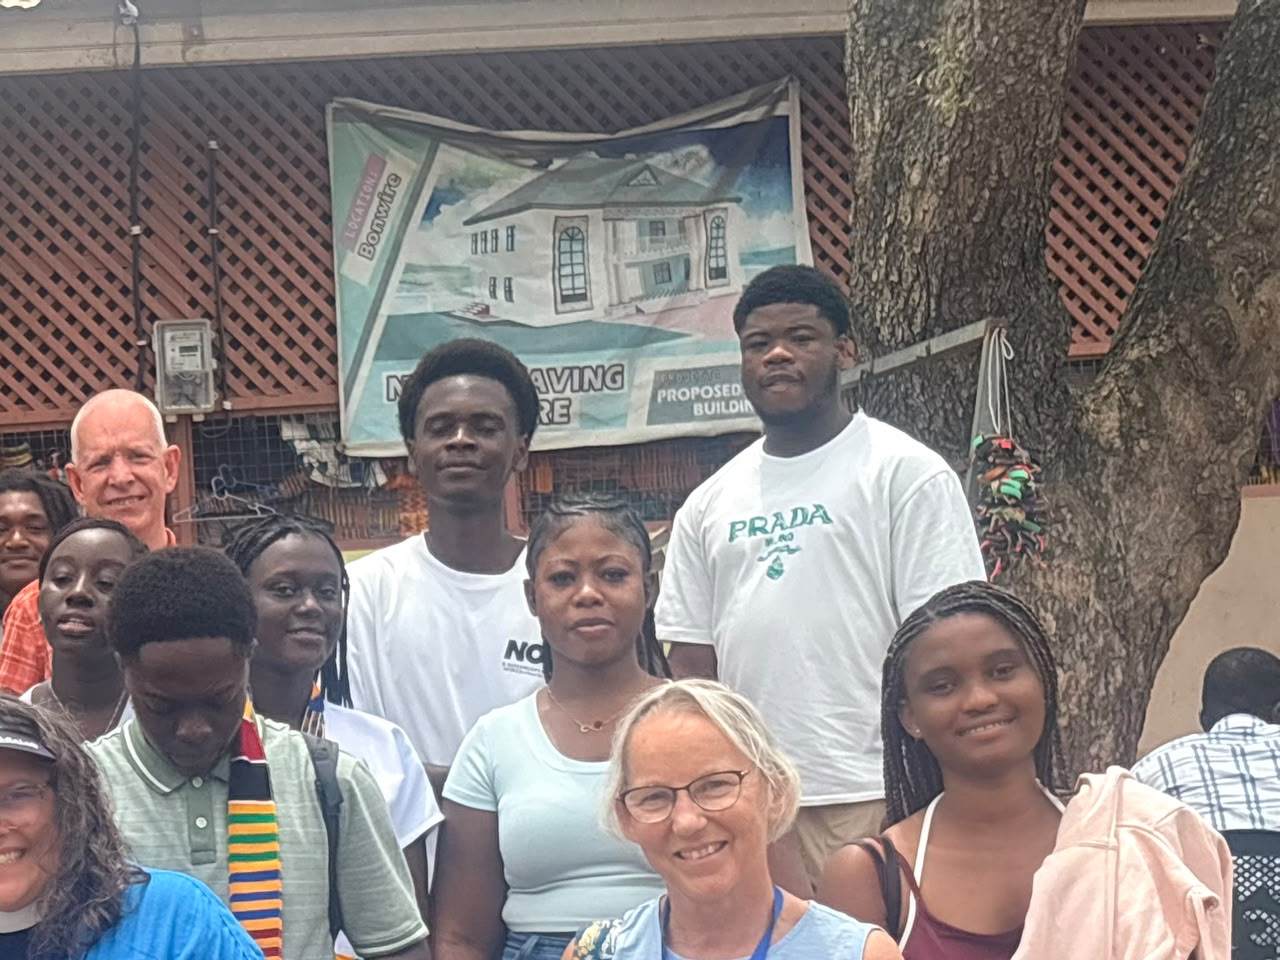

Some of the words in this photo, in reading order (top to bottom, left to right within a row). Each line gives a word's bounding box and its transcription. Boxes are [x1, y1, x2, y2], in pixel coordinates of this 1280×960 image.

[357, 173, 402, 261] Bonwire
[527, 363, 625, 394] AVING
[657, 383, 741, 403] PROPOSED
[728, 503, 833, 543] PRADA
